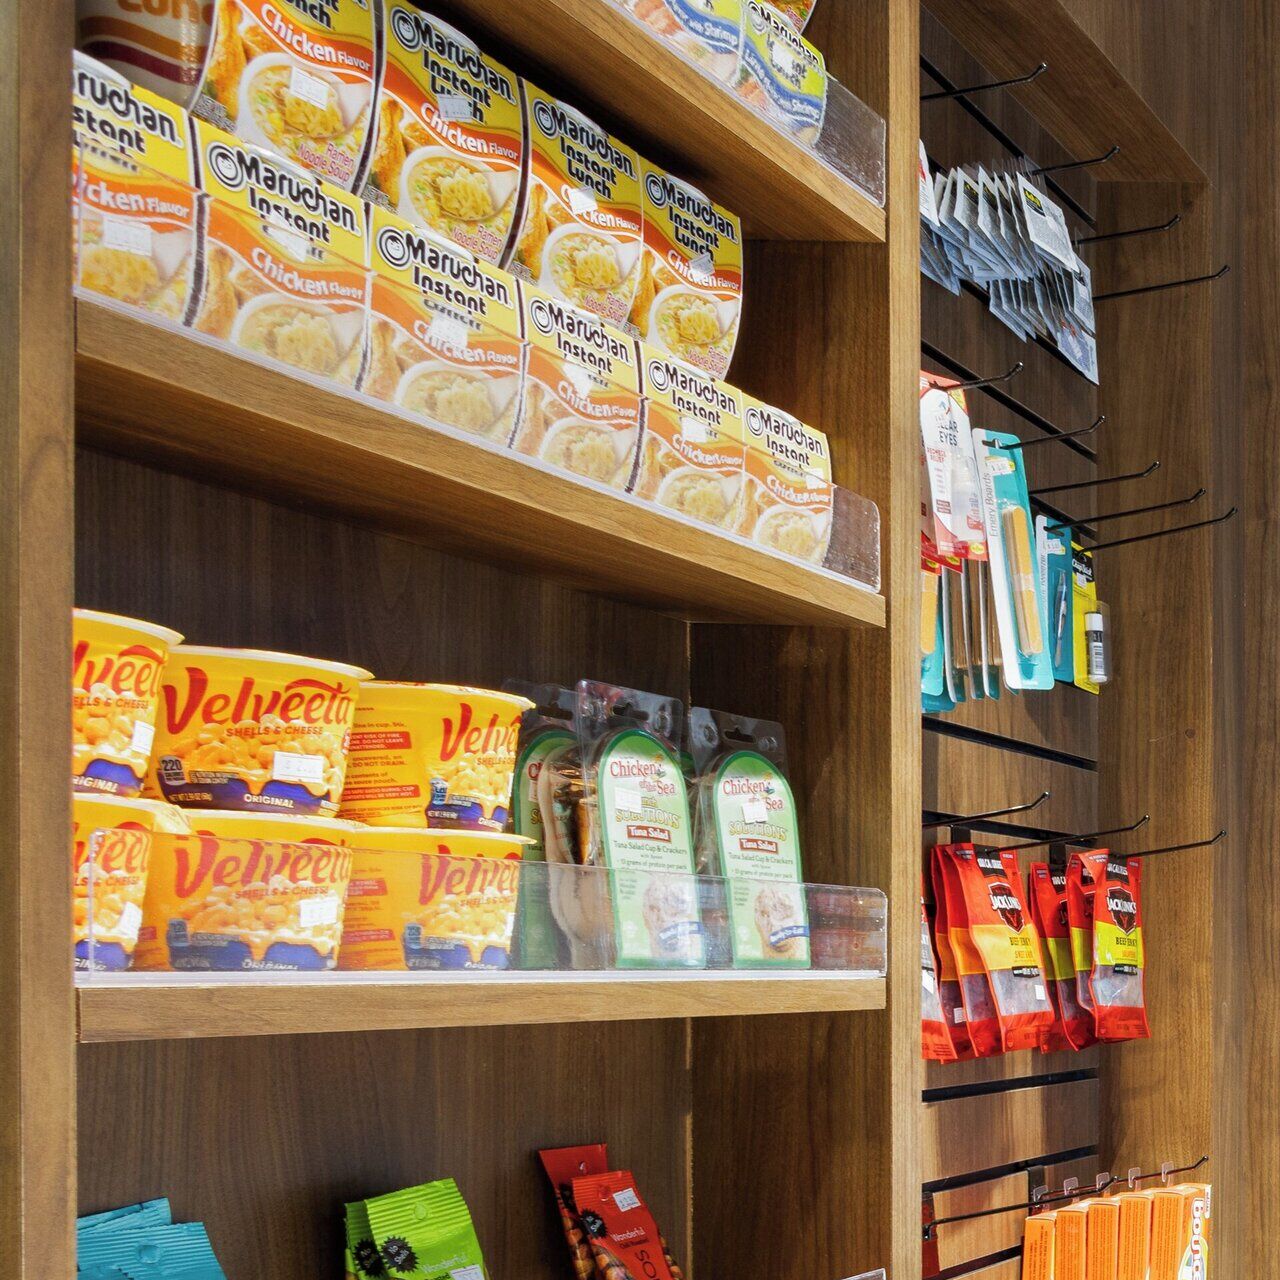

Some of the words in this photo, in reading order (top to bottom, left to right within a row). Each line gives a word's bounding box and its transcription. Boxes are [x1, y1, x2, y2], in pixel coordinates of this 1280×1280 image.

[262, 4, 337, 63] Chicken
[337, 52, 371, 72] Flavor
[413, 15, 512, 102] Maruchan
[423, 51, 491, 108] Instant
[421, 103, 488, 153] Chicken
[489, 144, 518, 160] Flavor
[550, 104, 633, 179] Maruchan
[299, 144, 328, 170] Noodle
[327, 161, 350, 182] Soup
[325, 143, 354, 168] Ramen
[560, 136, 617, 185] Instant
[236, 150, 356, 232] Maruchan
[567, 158, 611, 199] Lunch
[146, 197, 190, 218] Flavor
[616, 217, 640, 231] Flavor
[662, 177, 736, 242] Maruchan
[669, 207, 719, 249] Instant
[252, 247, 329, 295] Chicken
[405, 233, 509, 304] Maruchan
[414, 266, 486, 315] Instant
[550, 303, 629, 363] Maruchan
[557, 332, 612, 374] Instant
[665, 363, 737, 415] Maruchan
[672, 390, 721, 425] Instant
[760, 410, 823, 455] Maruchan
[766, 436, 810, 466] Instant
[982, 472, 995, 506] Boards
[986, 508, 998, 537] Emery
[161, 667, 353, 735] Velveeta
[162, 759, 182, 771] 220
[610, 760, 657, 777] Chicken
[243, 794, 294, 808] ORIGINAL
[656, 781, 676, 795] Sea
[722, 779, 766, 795] Chicken
[765, 799, 784, 811] Sea
[611, 1226, 647, 1243] Wonderful
